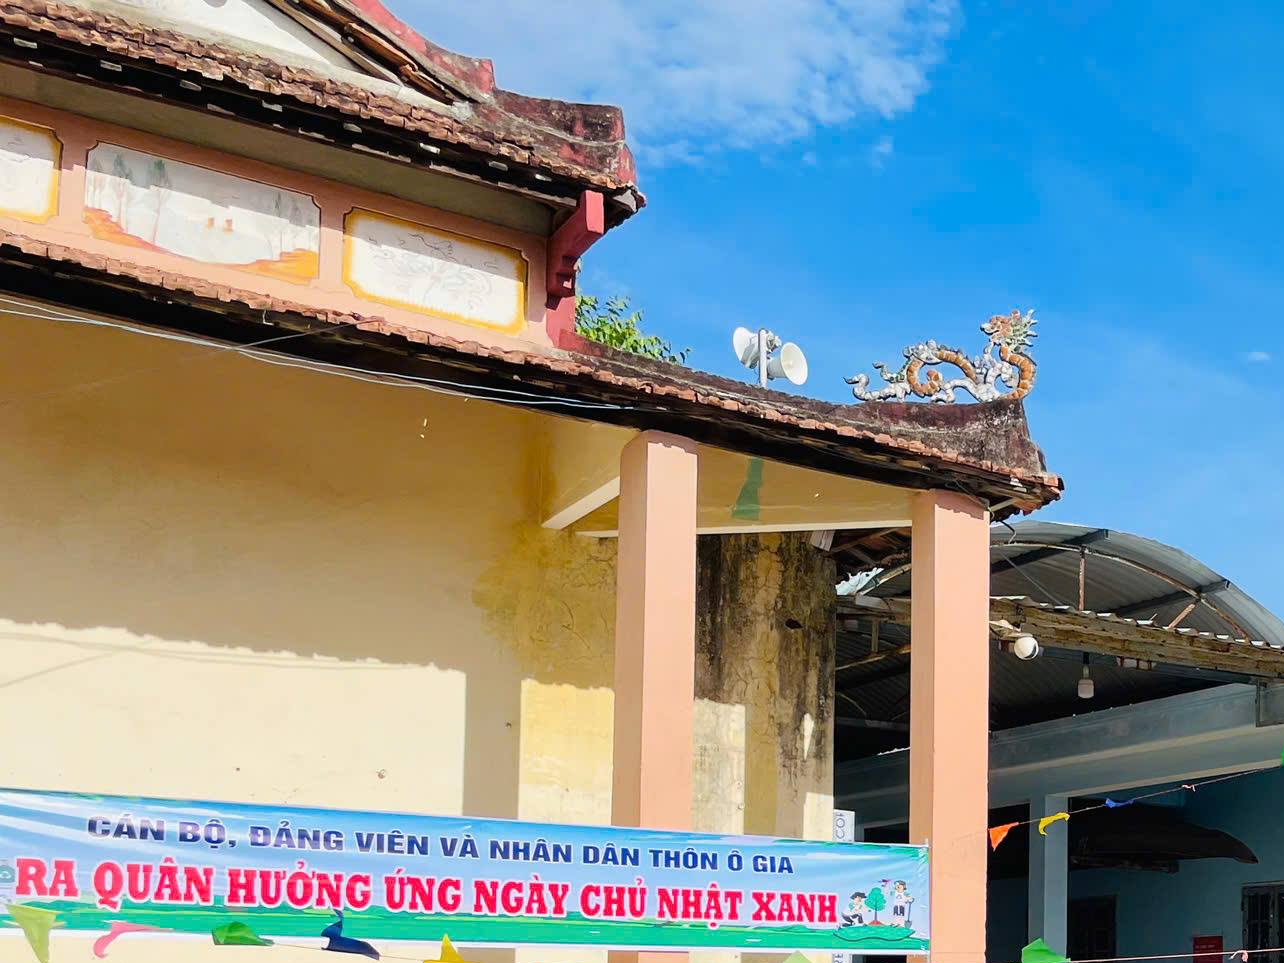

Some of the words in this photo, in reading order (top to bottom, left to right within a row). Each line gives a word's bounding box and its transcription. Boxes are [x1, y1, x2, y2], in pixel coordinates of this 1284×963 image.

[87, 813, 165, 842] CÁN
[178, 818, 237, 849] BỘ,
[249, 820, 344, 852] ĐẢNG
[354, 829, 430, 856] VIÊN
[440, 831, 480, 859] VÀ
[489, 838, 573, 863] NHÂN
[582, 842, 640, 867] DÂN
[649, 847, 719, 870] THÔN
[727, 849, 745, 872] Ô
[752, 854, 795, 875] GIA
[15, 858, 79, 898] RA
[92, 856, 215, 908] QUÂN
[226, 860, 372, 910] HƯỞNG
[383, 868, 462, 912] ỨNG
[472, 874, 570, 917] NGÀY
[580, 877, 648, 919] CHỦ
[657, 883, 743, 928] NHẬT
[751, 892, 838, 923] XANH
